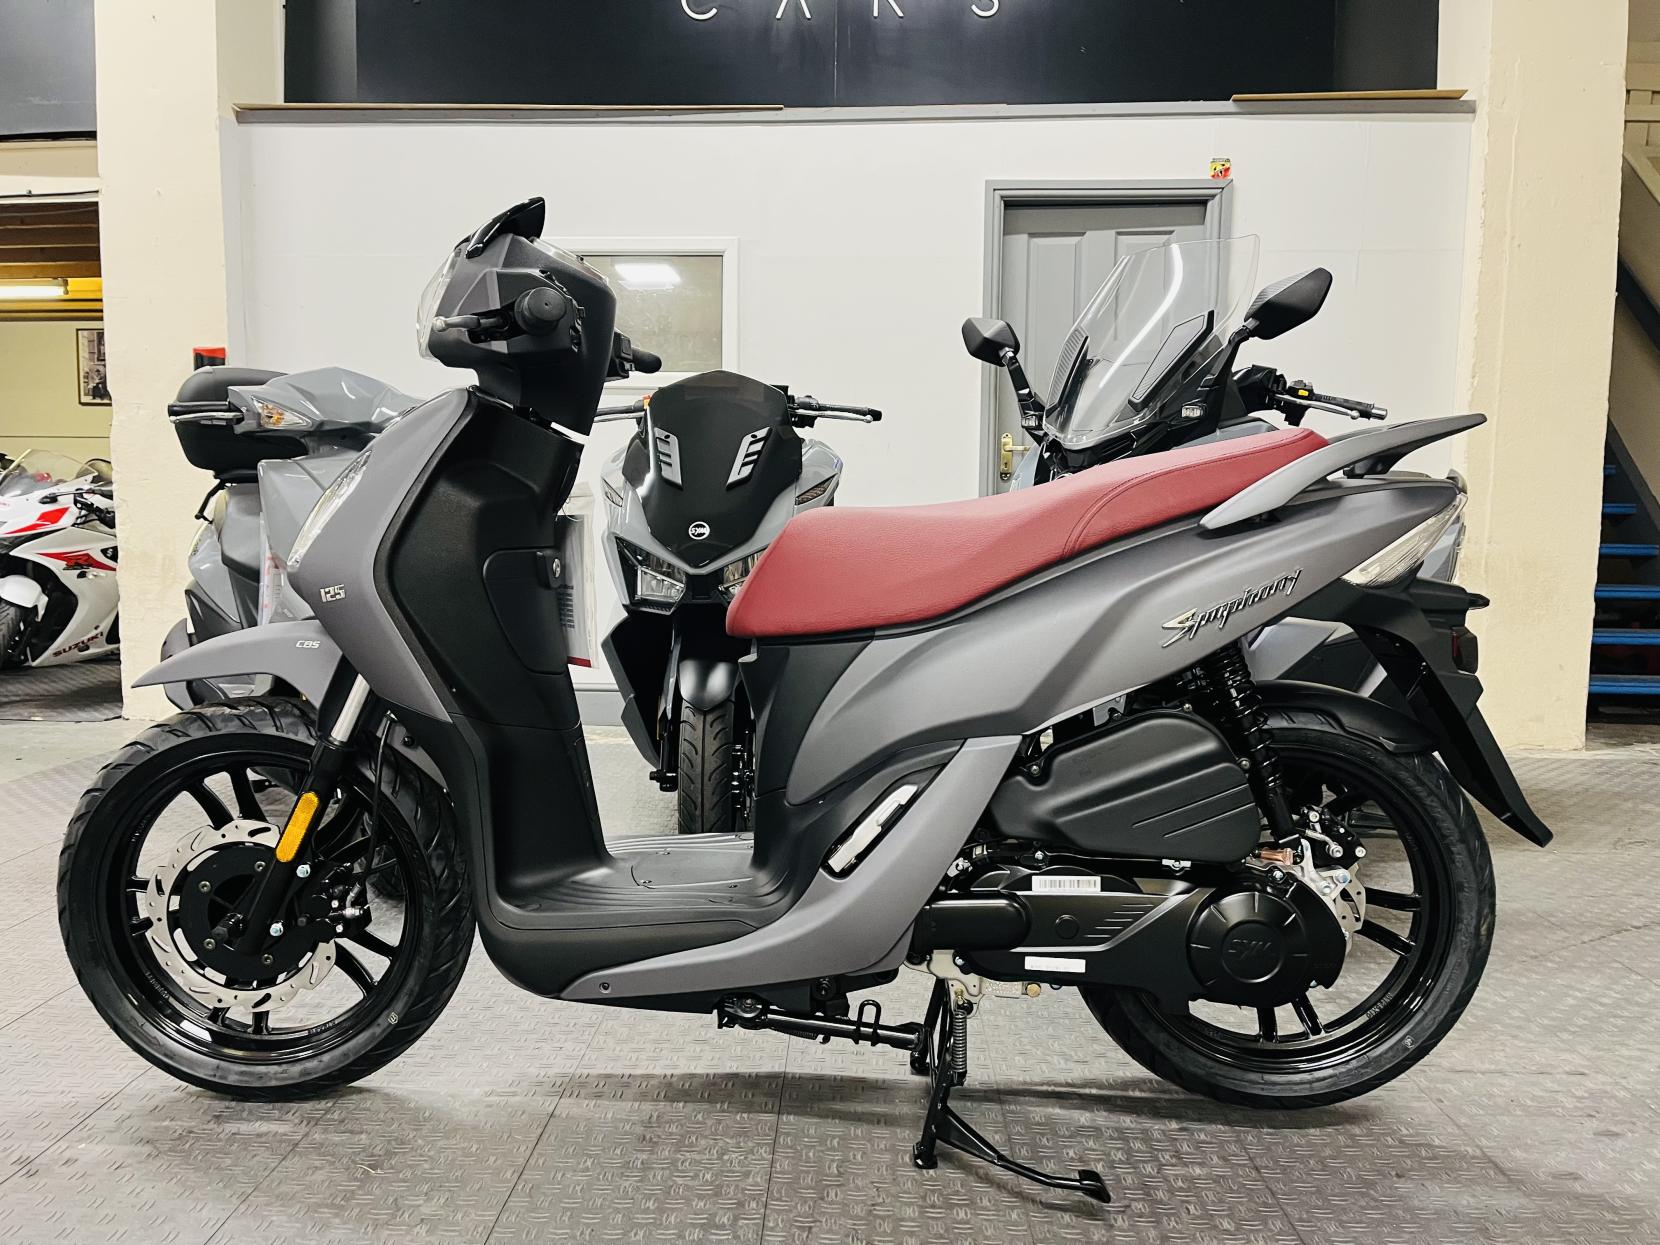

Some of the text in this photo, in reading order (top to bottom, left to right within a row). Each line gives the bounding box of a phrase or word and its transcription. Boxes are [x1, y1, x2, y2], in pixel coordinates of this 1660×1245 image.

[320, 584, 345, 602] 125
[1162, 568, 1303, 648] Symphony
[296, 640, 320, 649] CBS
